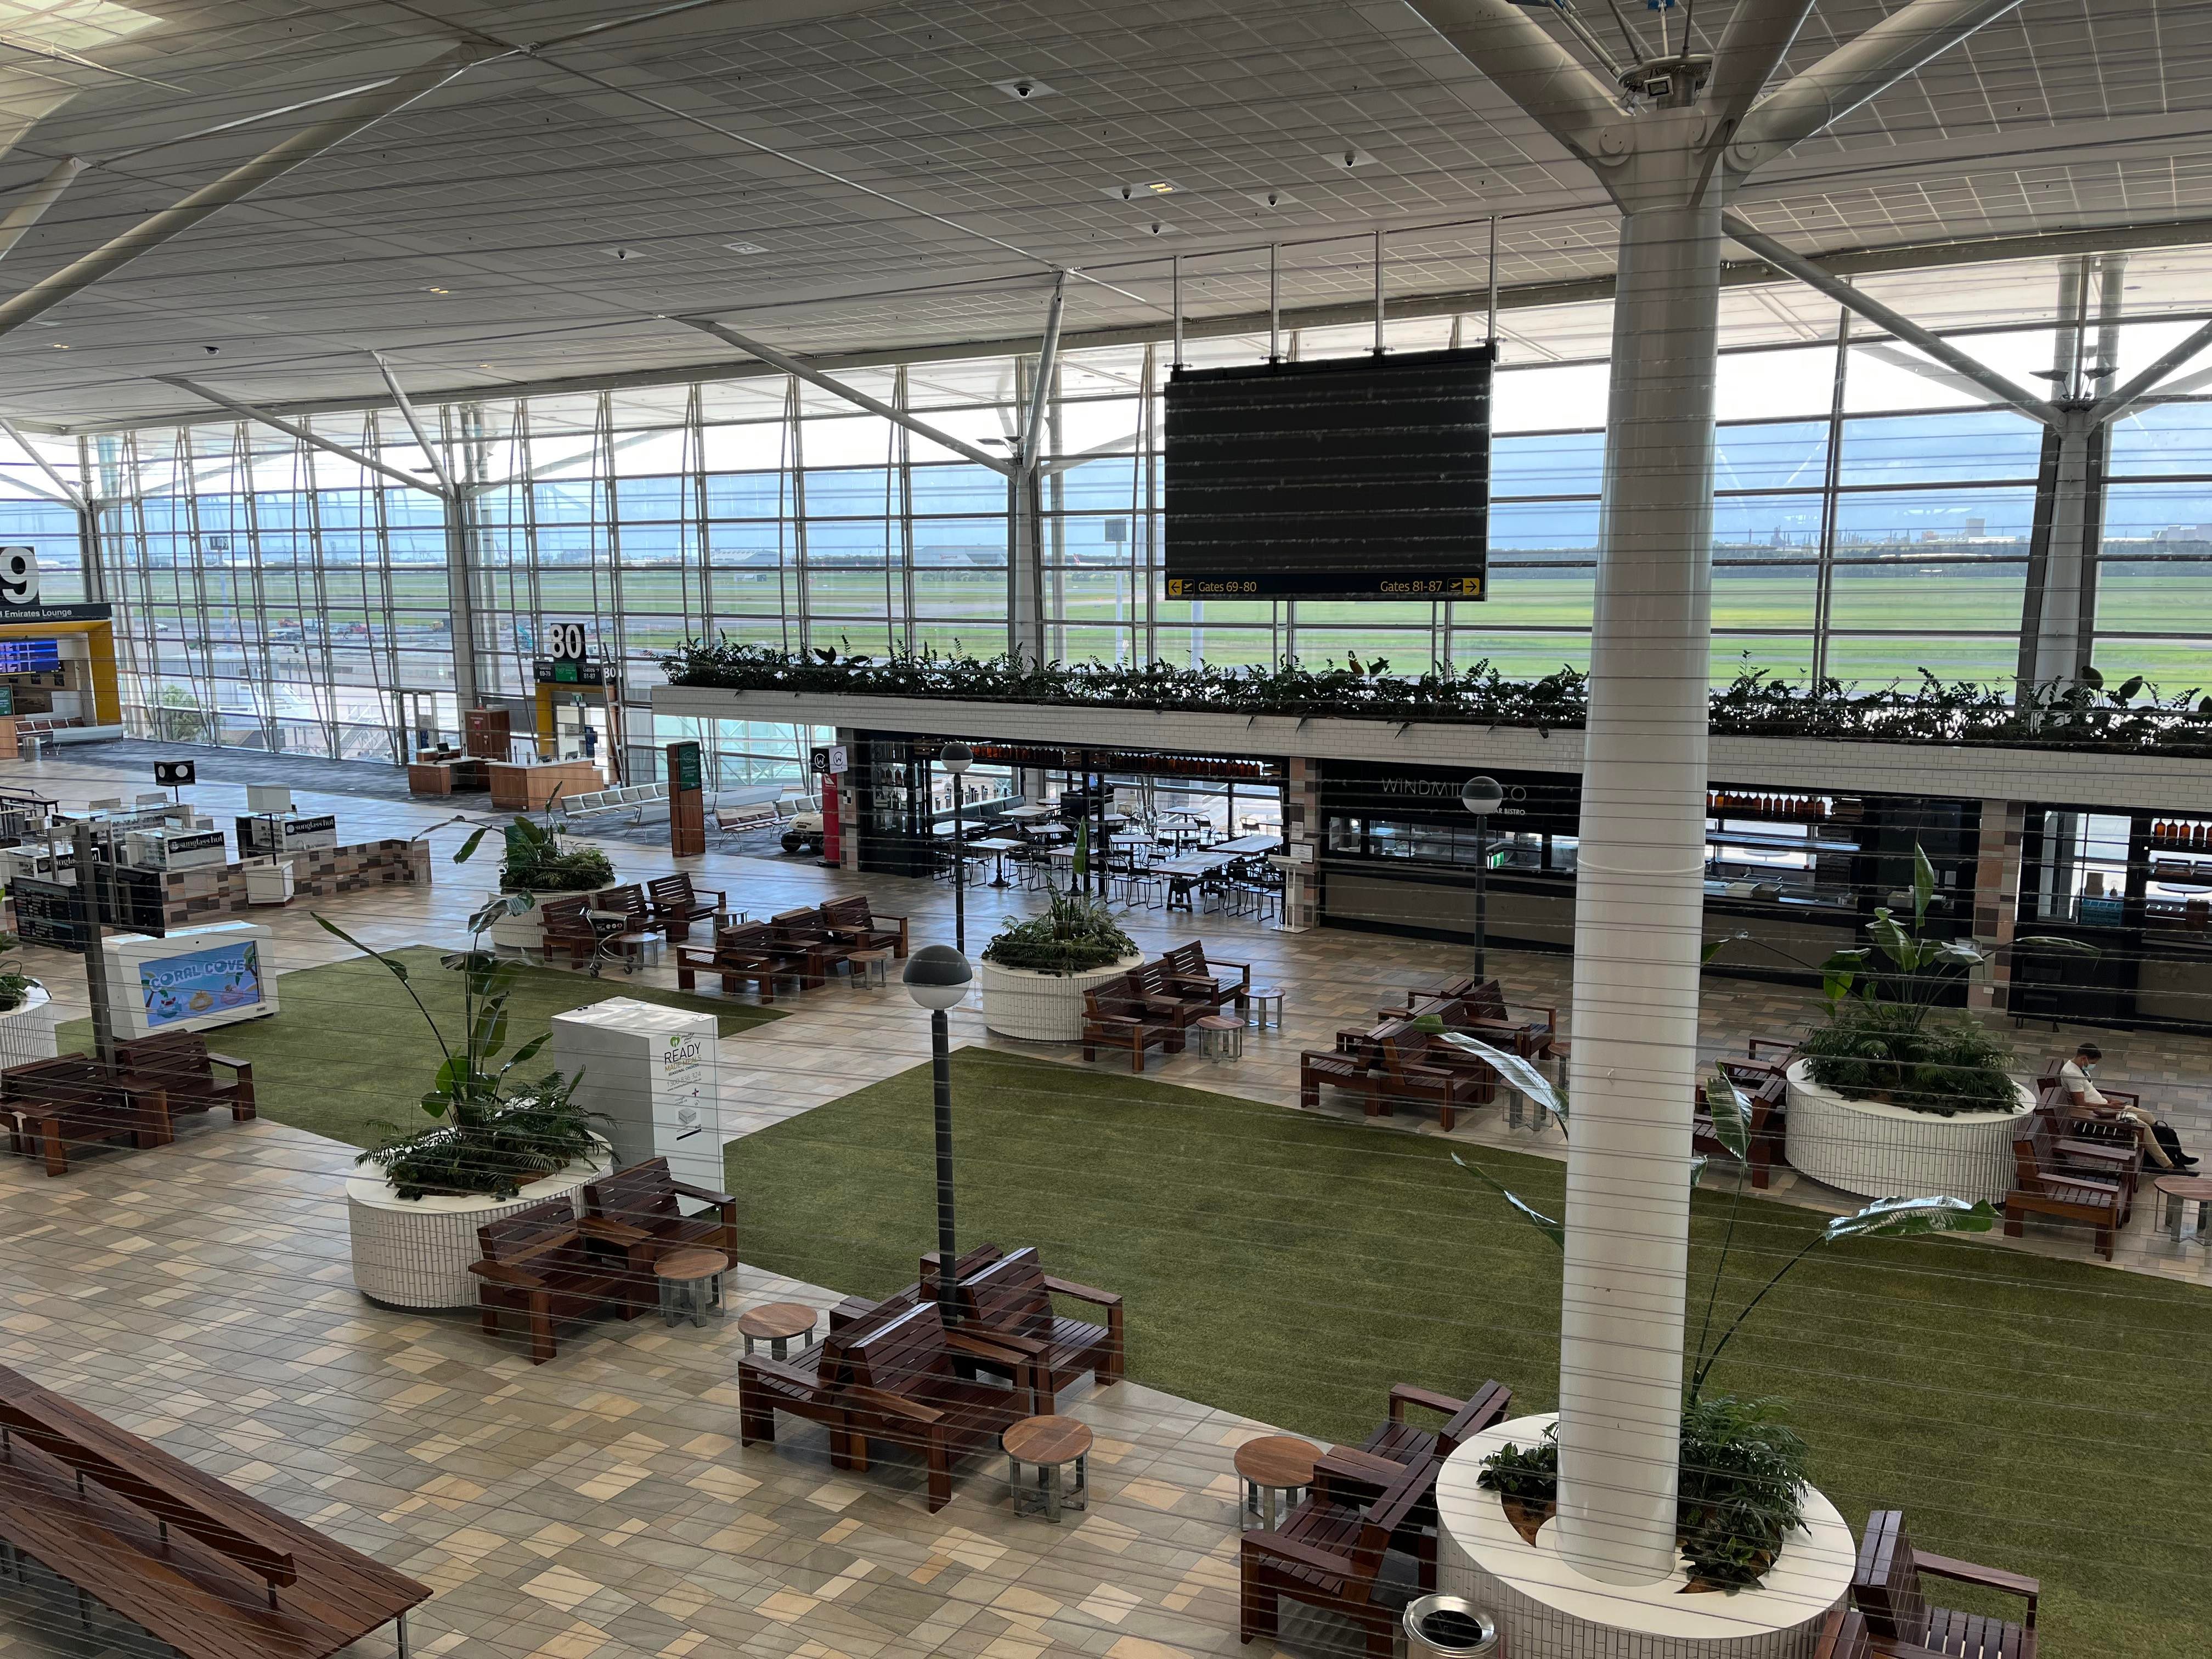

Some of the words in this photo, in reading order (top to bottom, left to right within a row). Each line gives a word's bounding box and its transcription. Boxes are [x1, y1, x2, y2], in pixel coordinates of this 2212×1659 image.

[0, 547, 39, 603] 9
[1199, 582, 1224, 592] Gates
[1226, 582, 1257, 592] 69-80
[1380, 581, 1410, 592] Gates
[1412, 580, 1443, 592] 81-87
[42, 609, 72, 617] Lounge
[550, 624, 582, 658] 80
[1381, 777, 1463, 798] WINDMIL
[295, 821, 323, 831] sunglass
[323, 819, 334, 827] hut
[178, 838, 210, 848] sunglass
[210, 835, 223, 843] hut
[150, 964, 201, 988] CORAL
[205, 959, 245, 973] COVE
[664, 1041, 701, 1065] READY
[664, 1062, 682, 1072] MADE
[682, 1054, 702, 1066] MEALS
